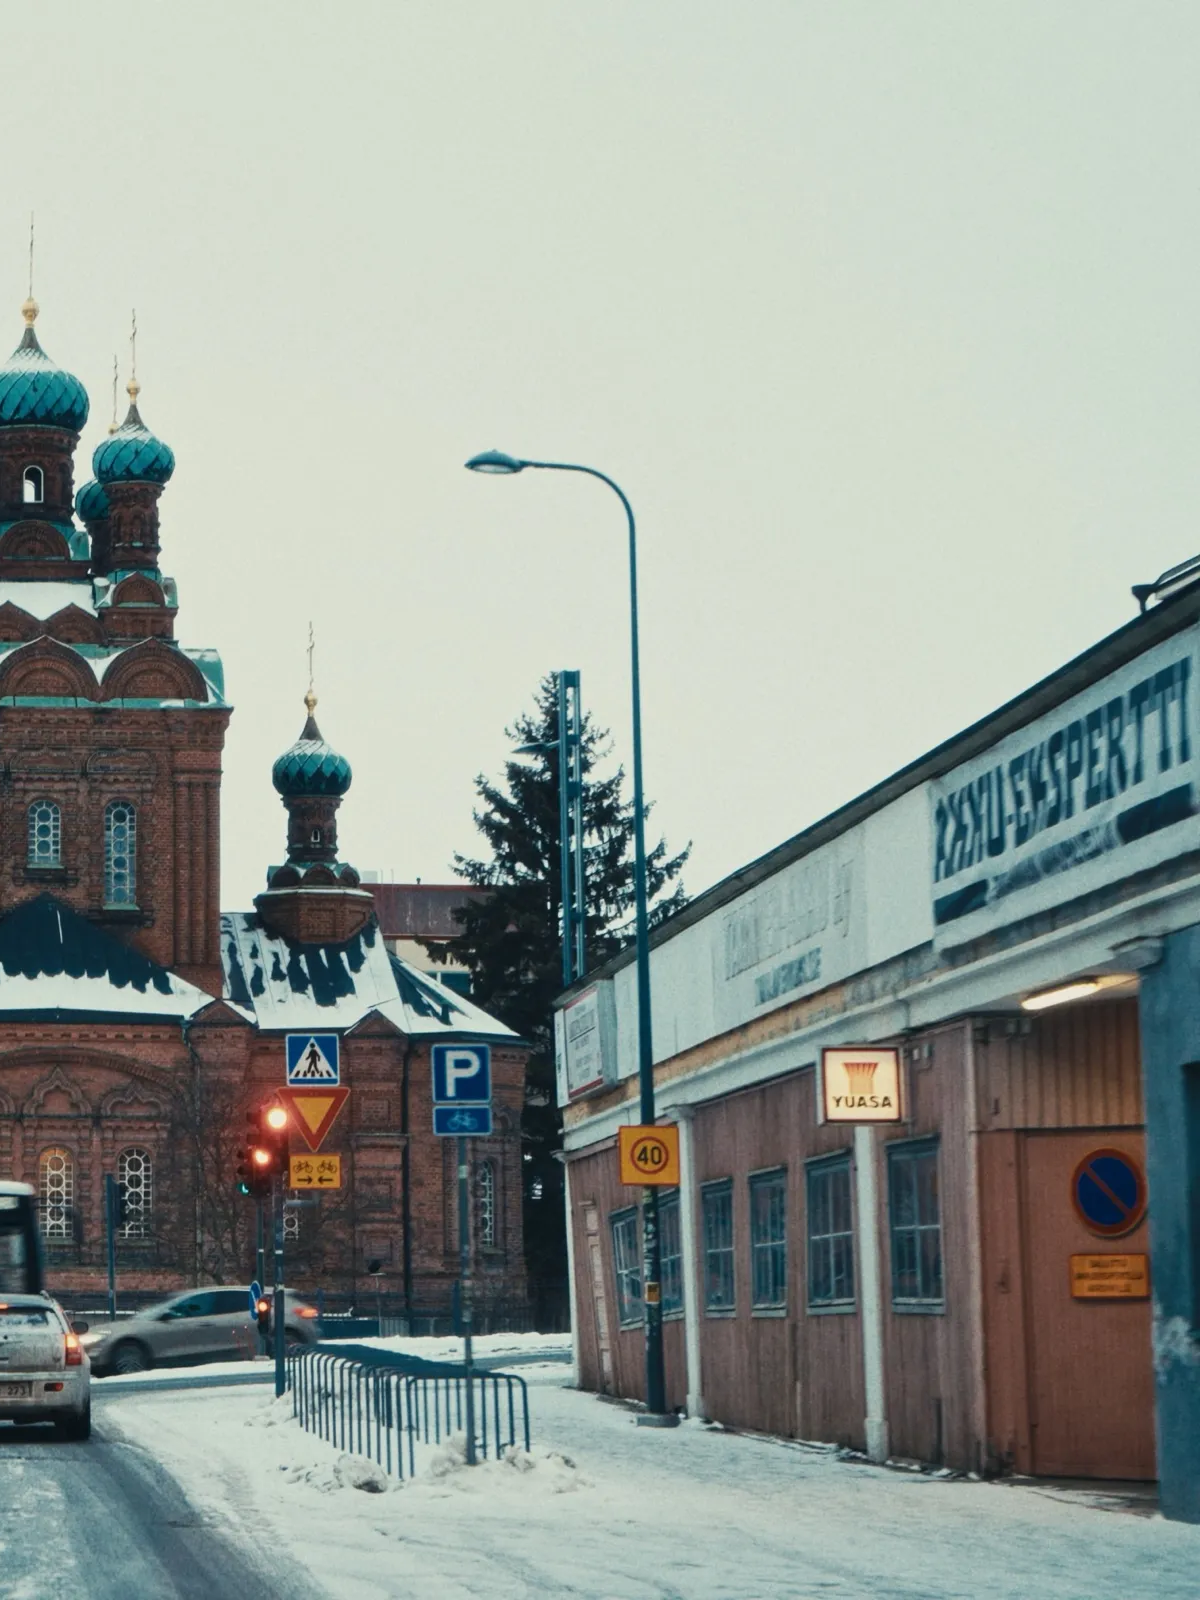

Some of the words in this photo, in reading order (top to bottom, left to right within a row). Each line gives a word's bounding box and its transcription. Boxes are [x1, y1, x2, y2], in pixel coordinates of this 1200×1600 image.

[445, 1050, 480, 1097] P
[832, 1096, 892, 1108] YUASA
[637, 1146, 662, 1165] 40
